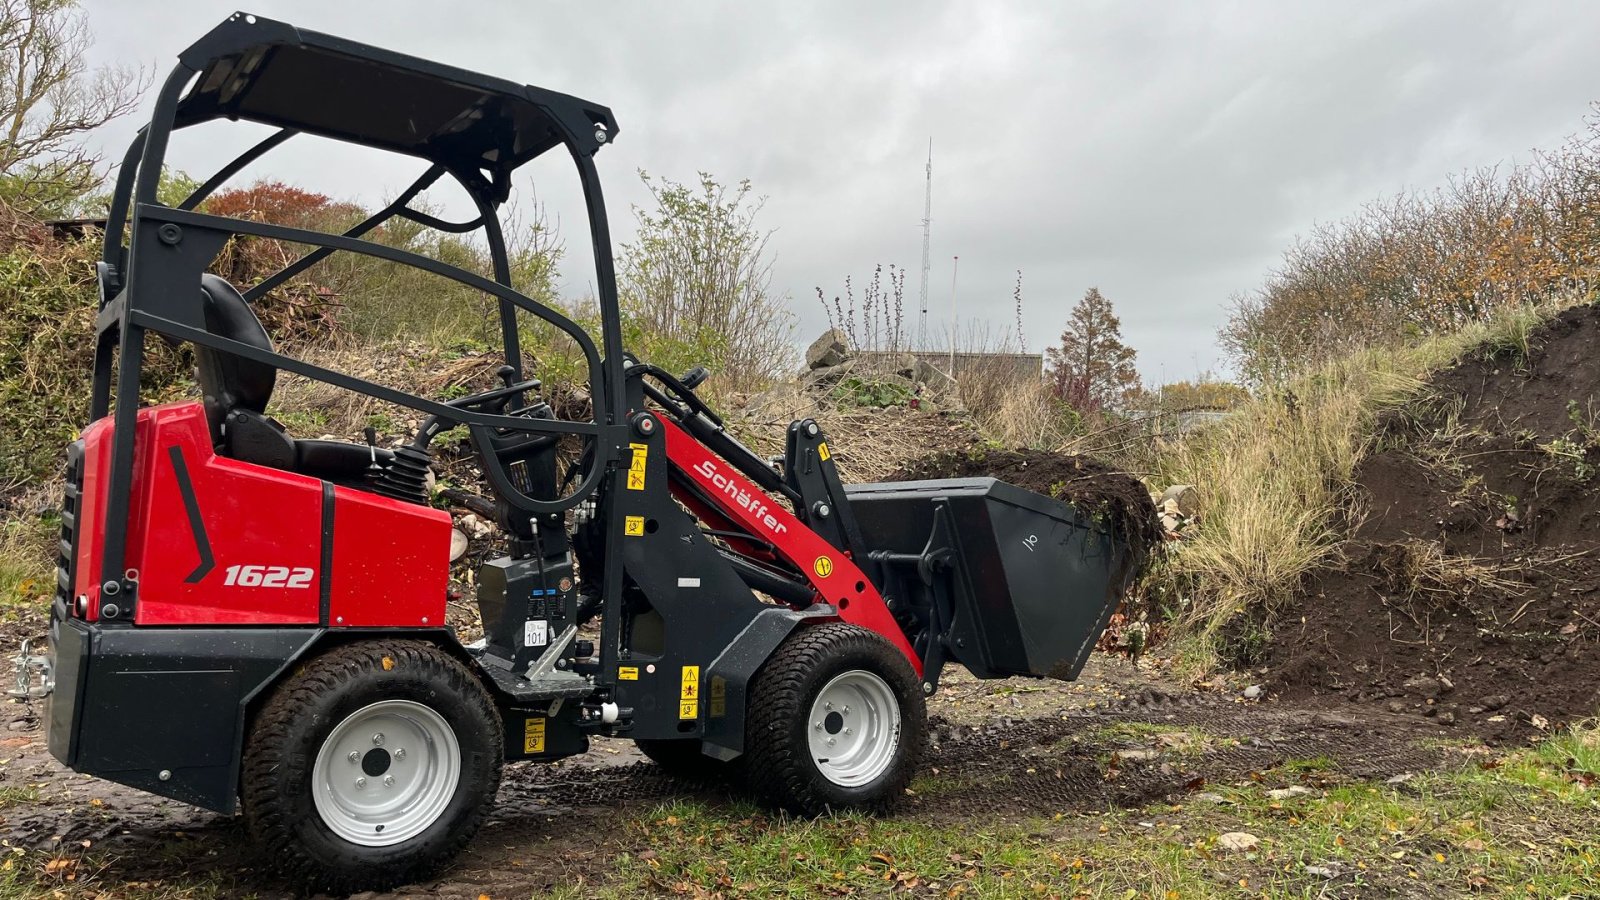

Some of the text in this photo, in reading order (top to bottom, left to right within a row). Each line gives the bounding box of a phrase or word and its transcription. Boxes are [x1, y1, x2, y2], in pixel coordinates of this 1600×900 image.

[693, 461, 787, 534] Schäffer
[223, 565, 315, 589] 1622
[527, 632, 541, 645] 101
